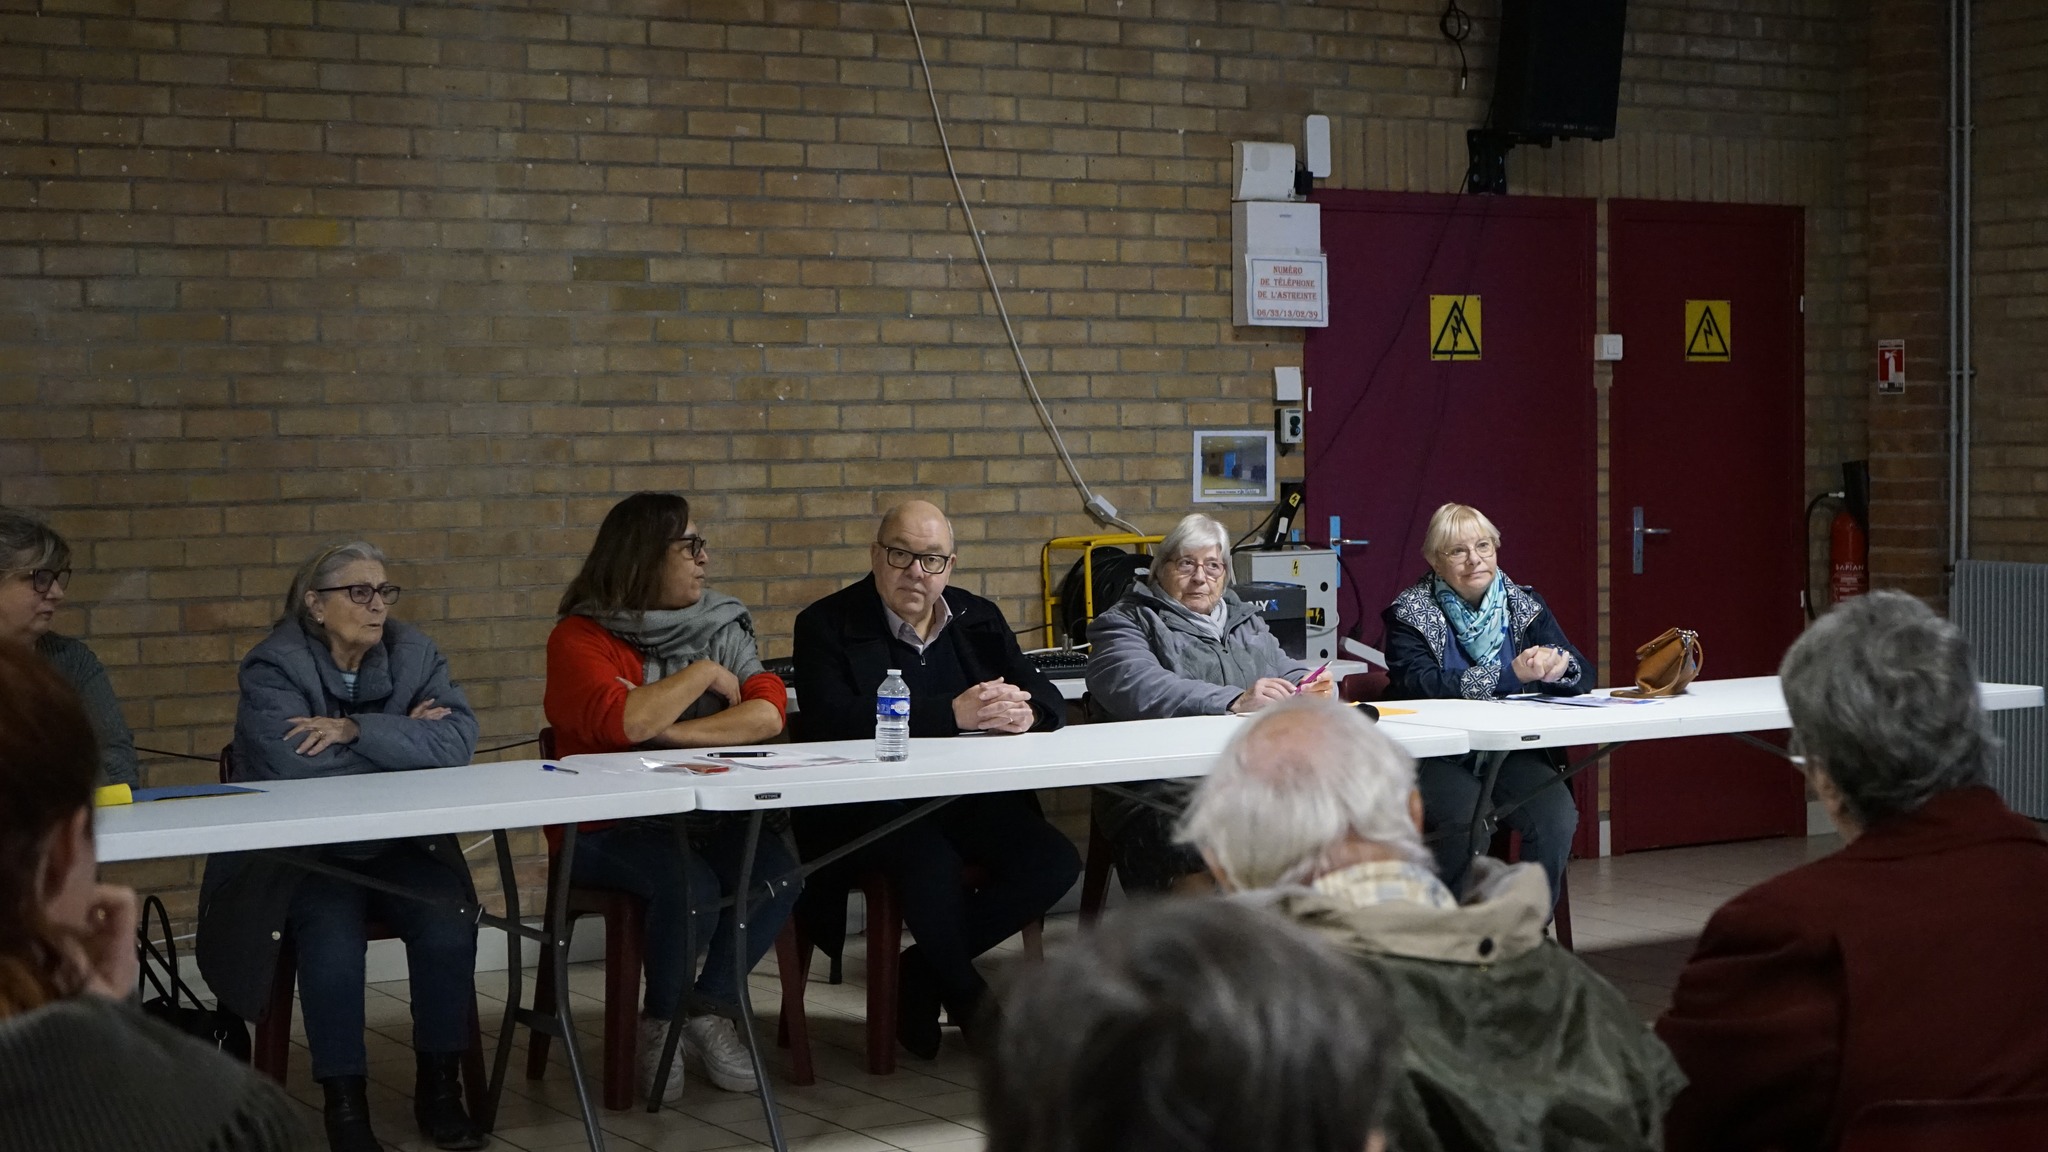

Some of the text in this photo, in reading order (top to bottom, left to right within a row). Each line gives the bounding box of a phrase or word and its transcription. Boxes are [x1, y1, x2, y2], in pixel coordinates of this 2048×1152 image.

[1273, 265, 1303, 275] NUMÉRO
[1260, 278, 1315, 288] DE TÉLÉPHONE
[1271, 291, 1317, 300] L'ASTREINTE
